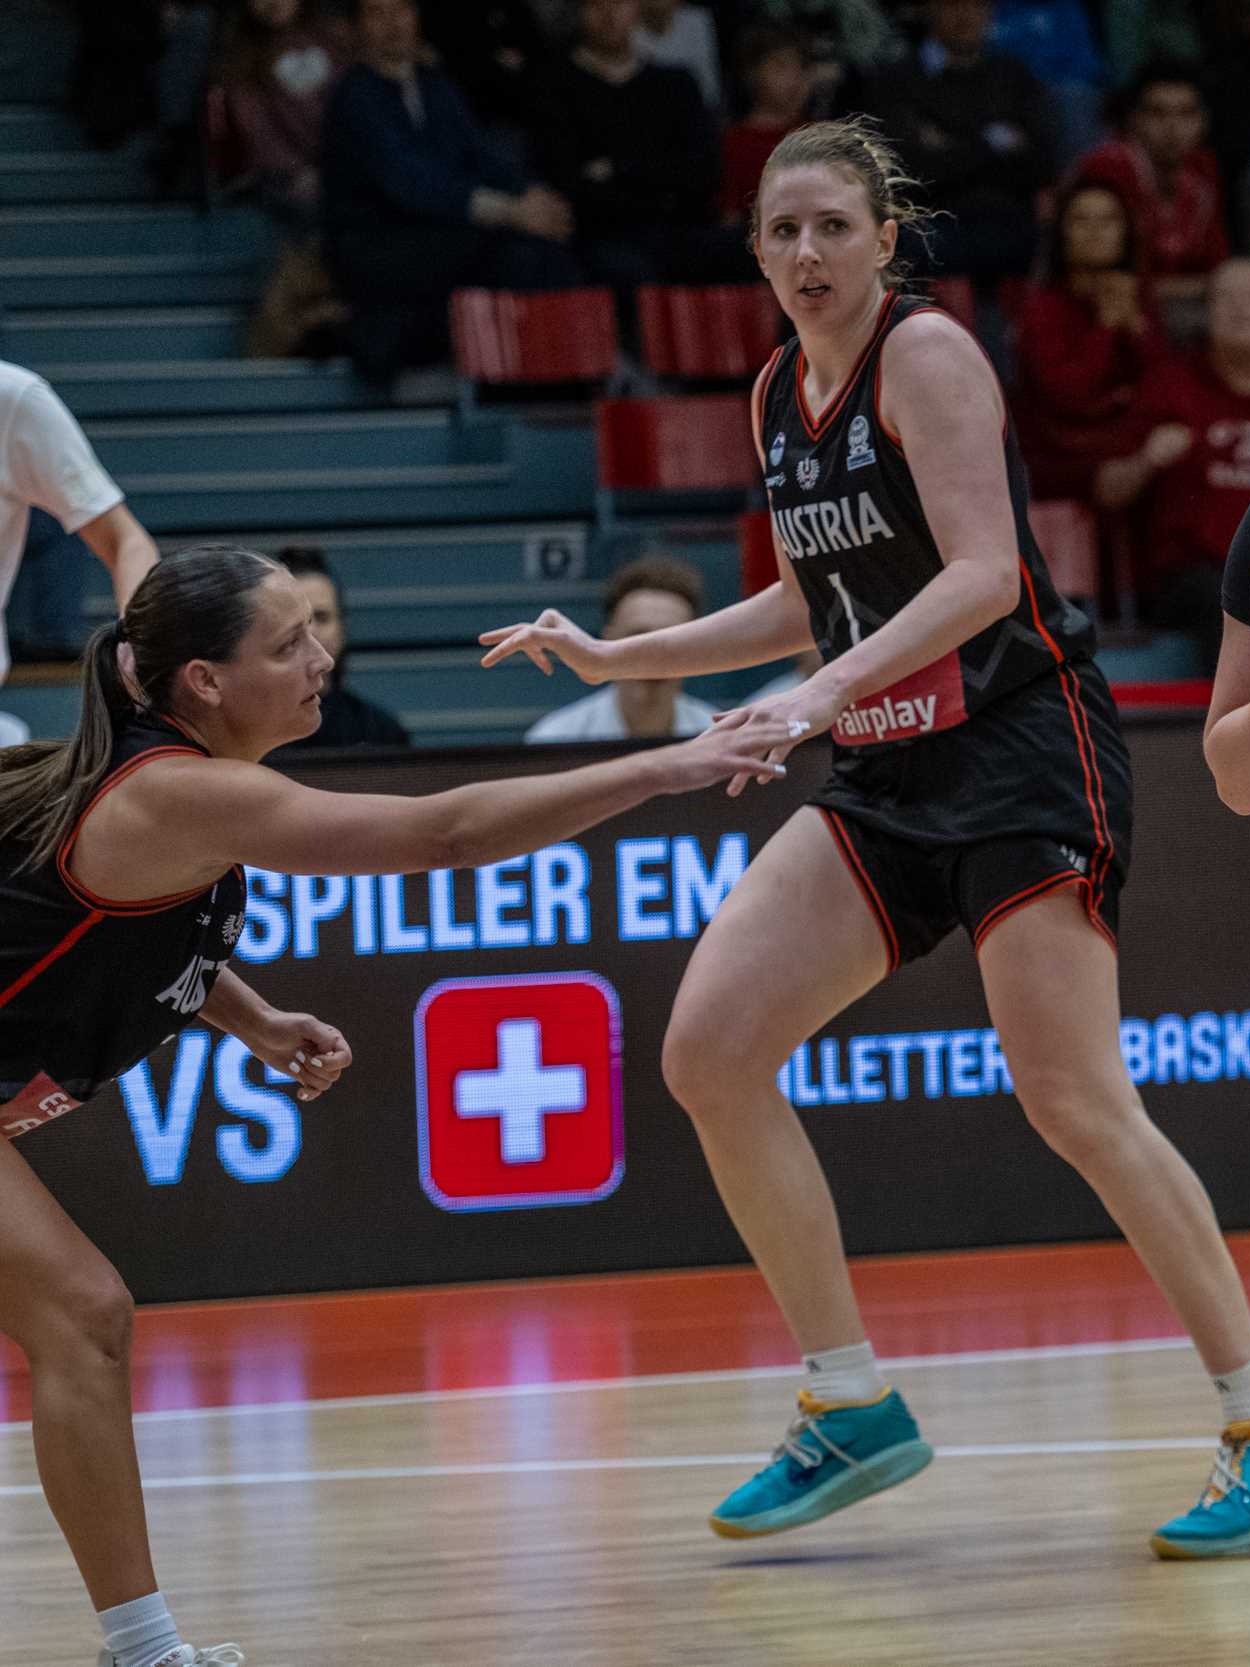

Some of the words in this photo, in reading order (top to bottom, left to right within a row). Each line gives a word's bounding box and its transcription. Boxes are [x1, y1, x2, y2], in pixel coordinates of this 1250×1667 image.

[234, 840, 593, 965] SPILLER
[614, 832, 750, 942] EM
[118, 1028, 302, 1186] VS
